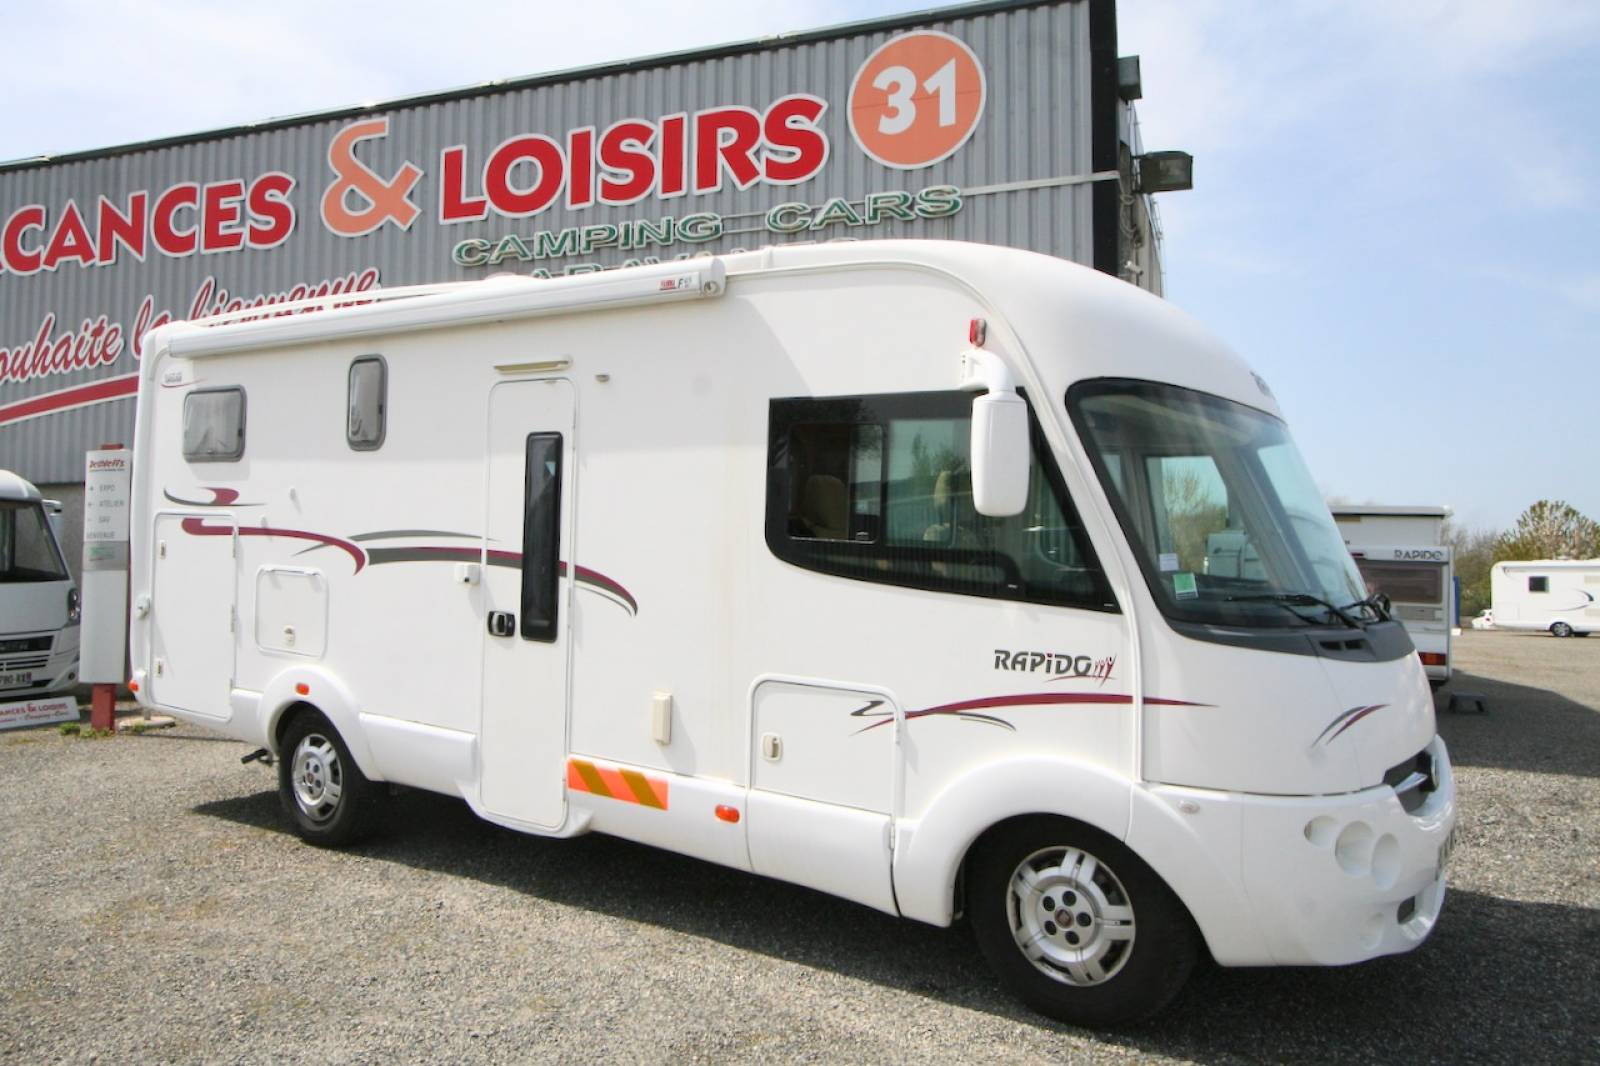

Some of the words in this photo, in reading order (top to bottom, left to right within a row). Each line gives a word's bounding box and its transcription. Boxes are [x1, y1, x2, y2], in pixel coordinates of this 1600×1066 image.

[0, 172, 295, 276] CANCES
[321, 117, 424, 237] &
[440, 94, 829, 224] LOISIRS
[872, 58, 956, 134] 31
[453, 212, 723, 266] CAMPING
[766, 185, 963, 233] CARS
